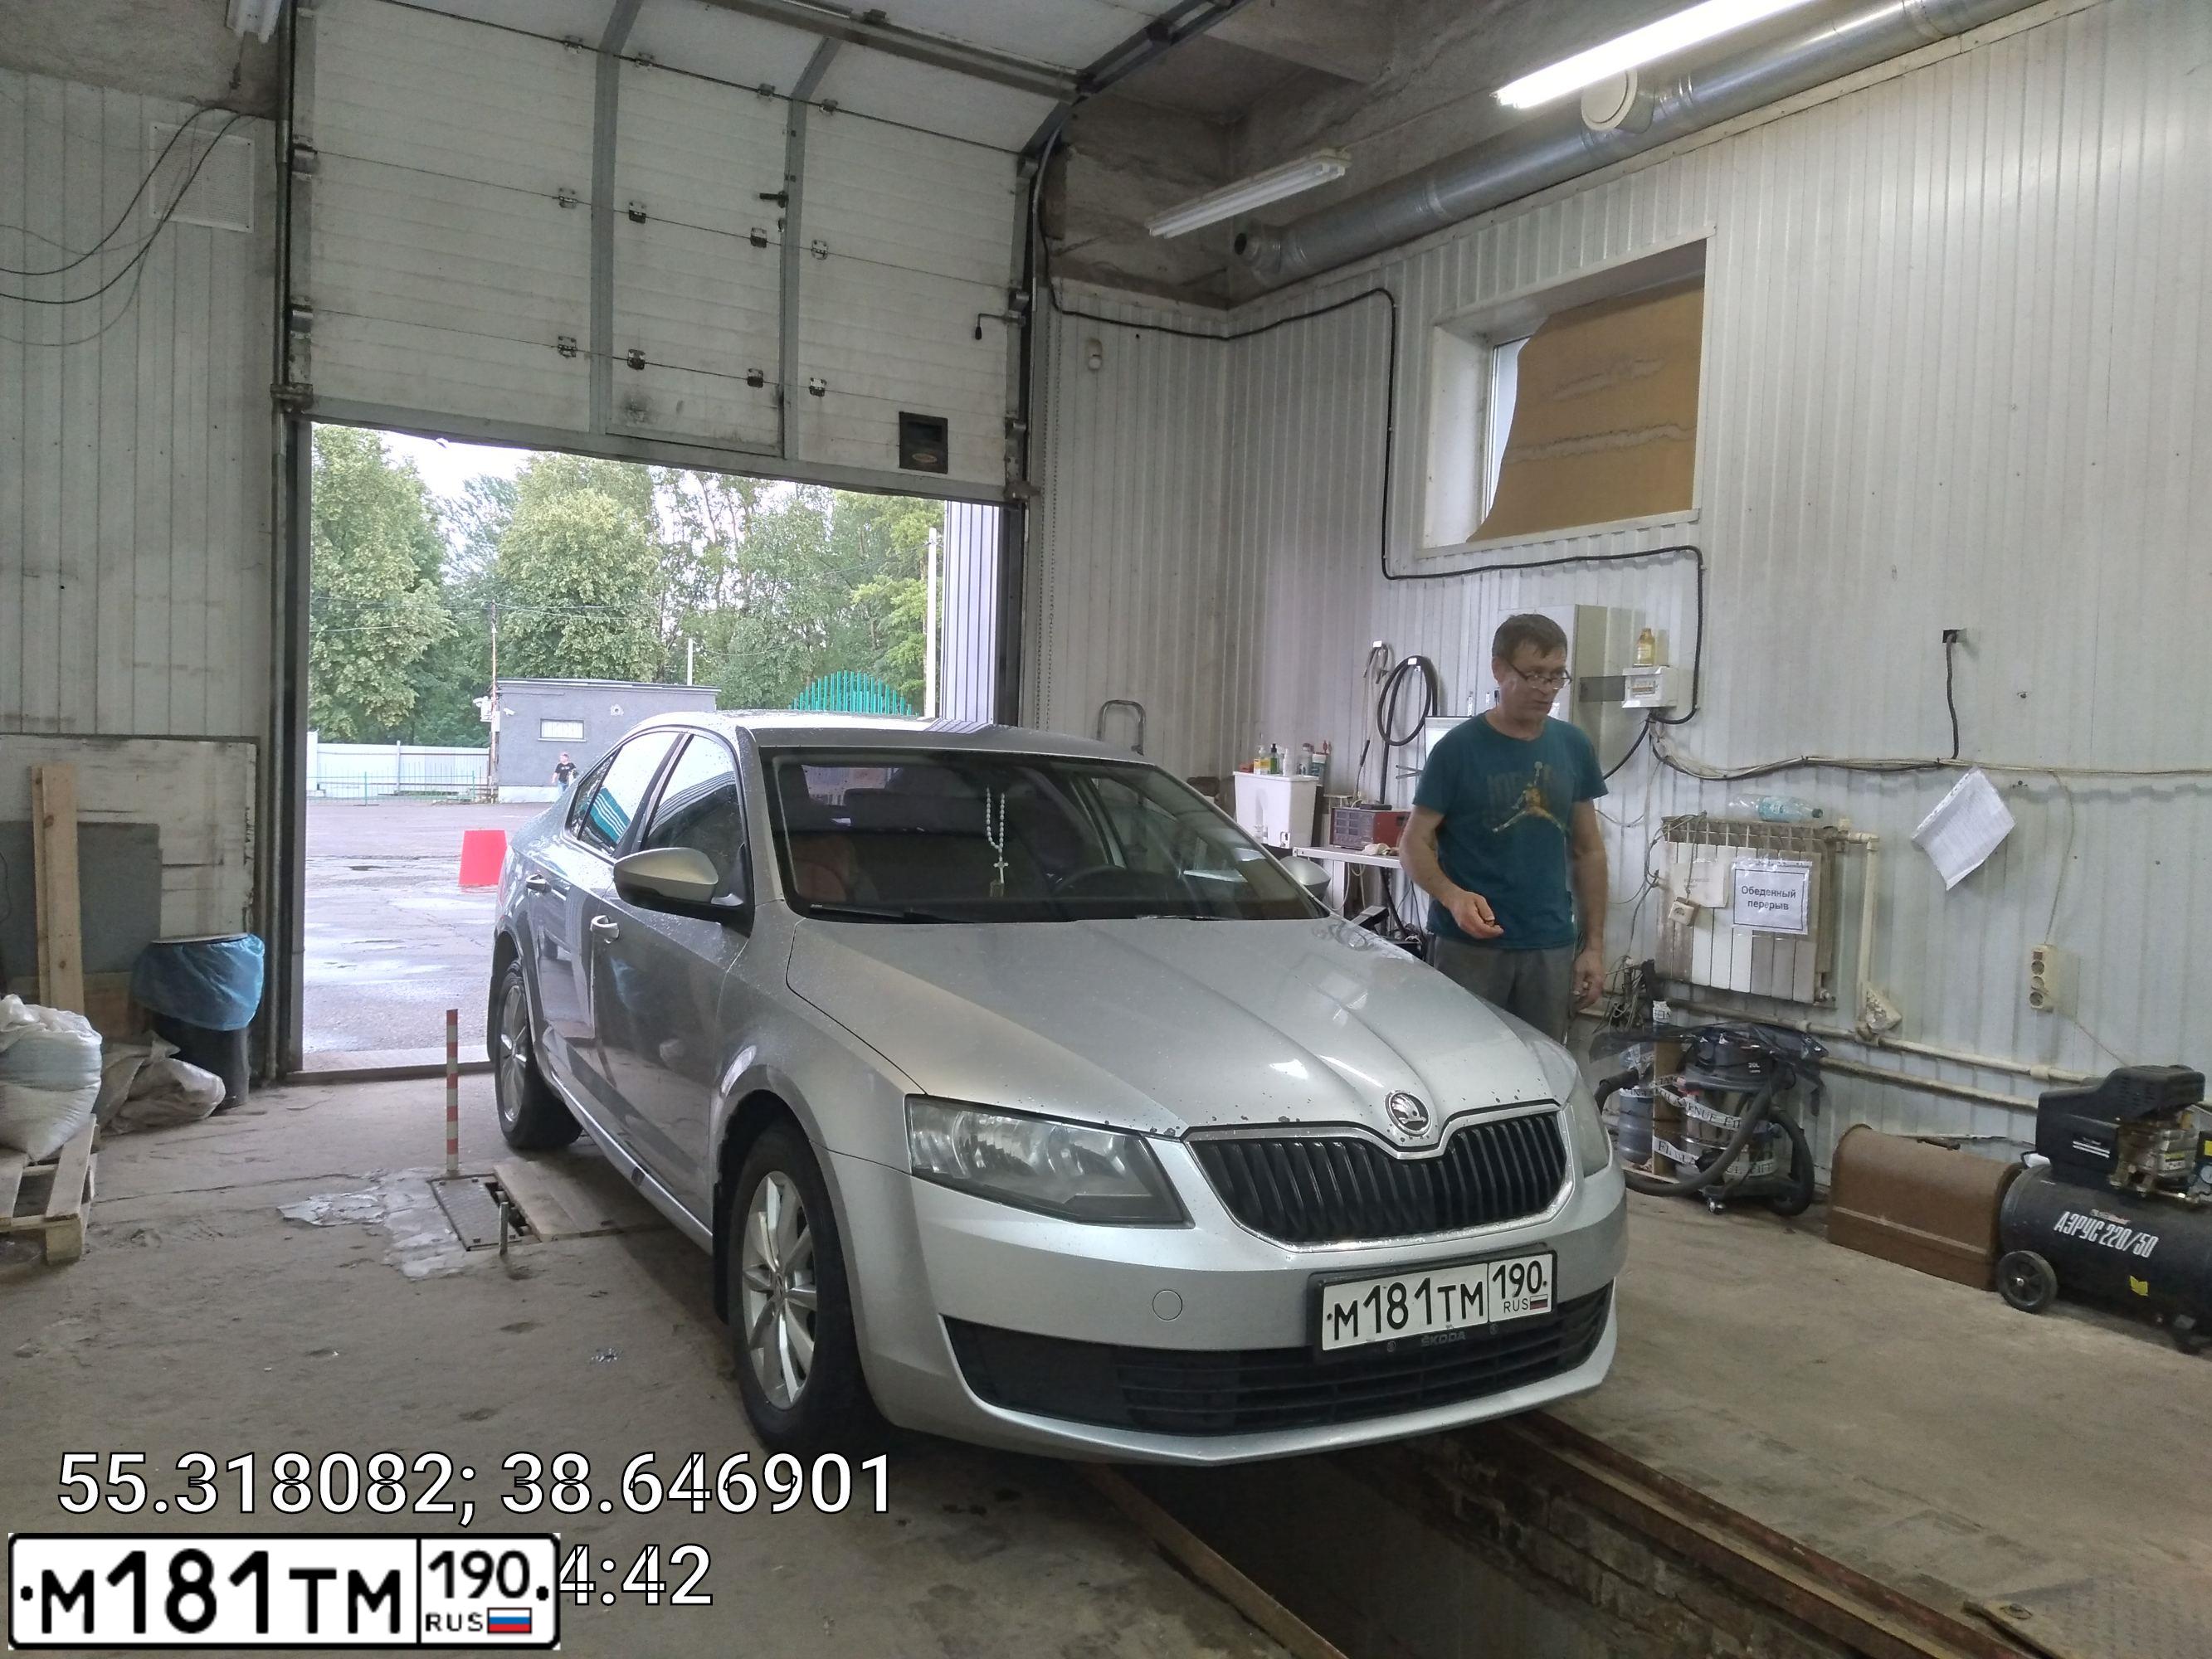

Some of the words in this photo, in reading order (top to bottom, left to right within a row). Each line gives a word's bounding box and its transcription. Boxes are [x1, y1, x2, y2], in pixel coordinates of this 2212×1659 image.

[1741, 885, 1796, 898] Обеденный
[1747, 900, 1790, 911] перерыв
[2098, 1224, 2159, 1258] 220/50
[1492, 1260, 1543, 1300] 190
[1503, 1299, 1529, 1314] RUS
